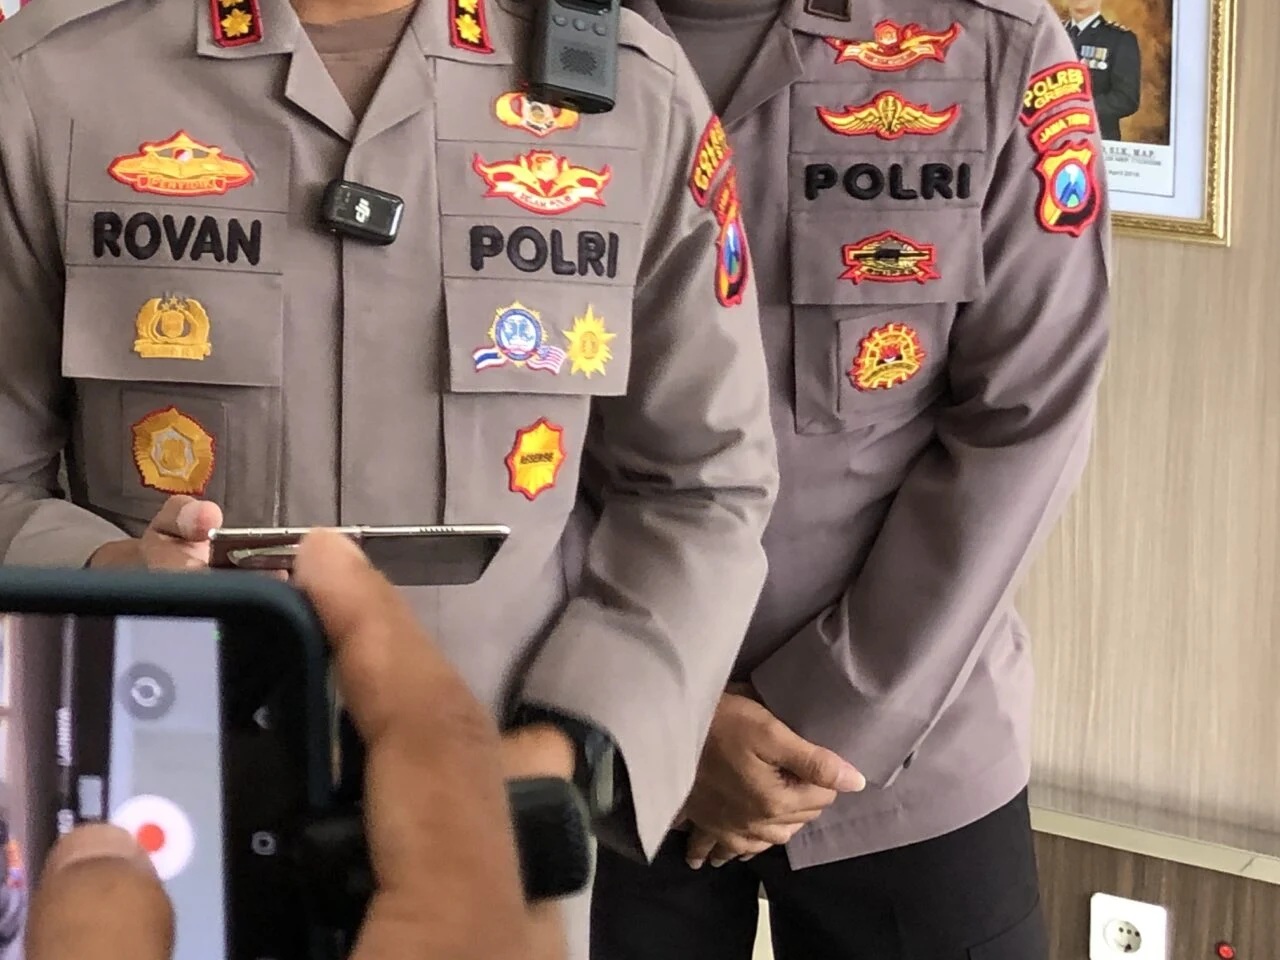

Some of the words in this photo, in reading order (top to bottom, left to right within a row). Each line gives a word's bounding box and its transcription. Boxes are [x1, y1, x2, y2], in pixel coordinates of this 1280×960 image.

[804, 162, 971, 201] POLRI
[92, 210, 262, 266] ROVAN
[469, 224, 620, 279] POLRI
